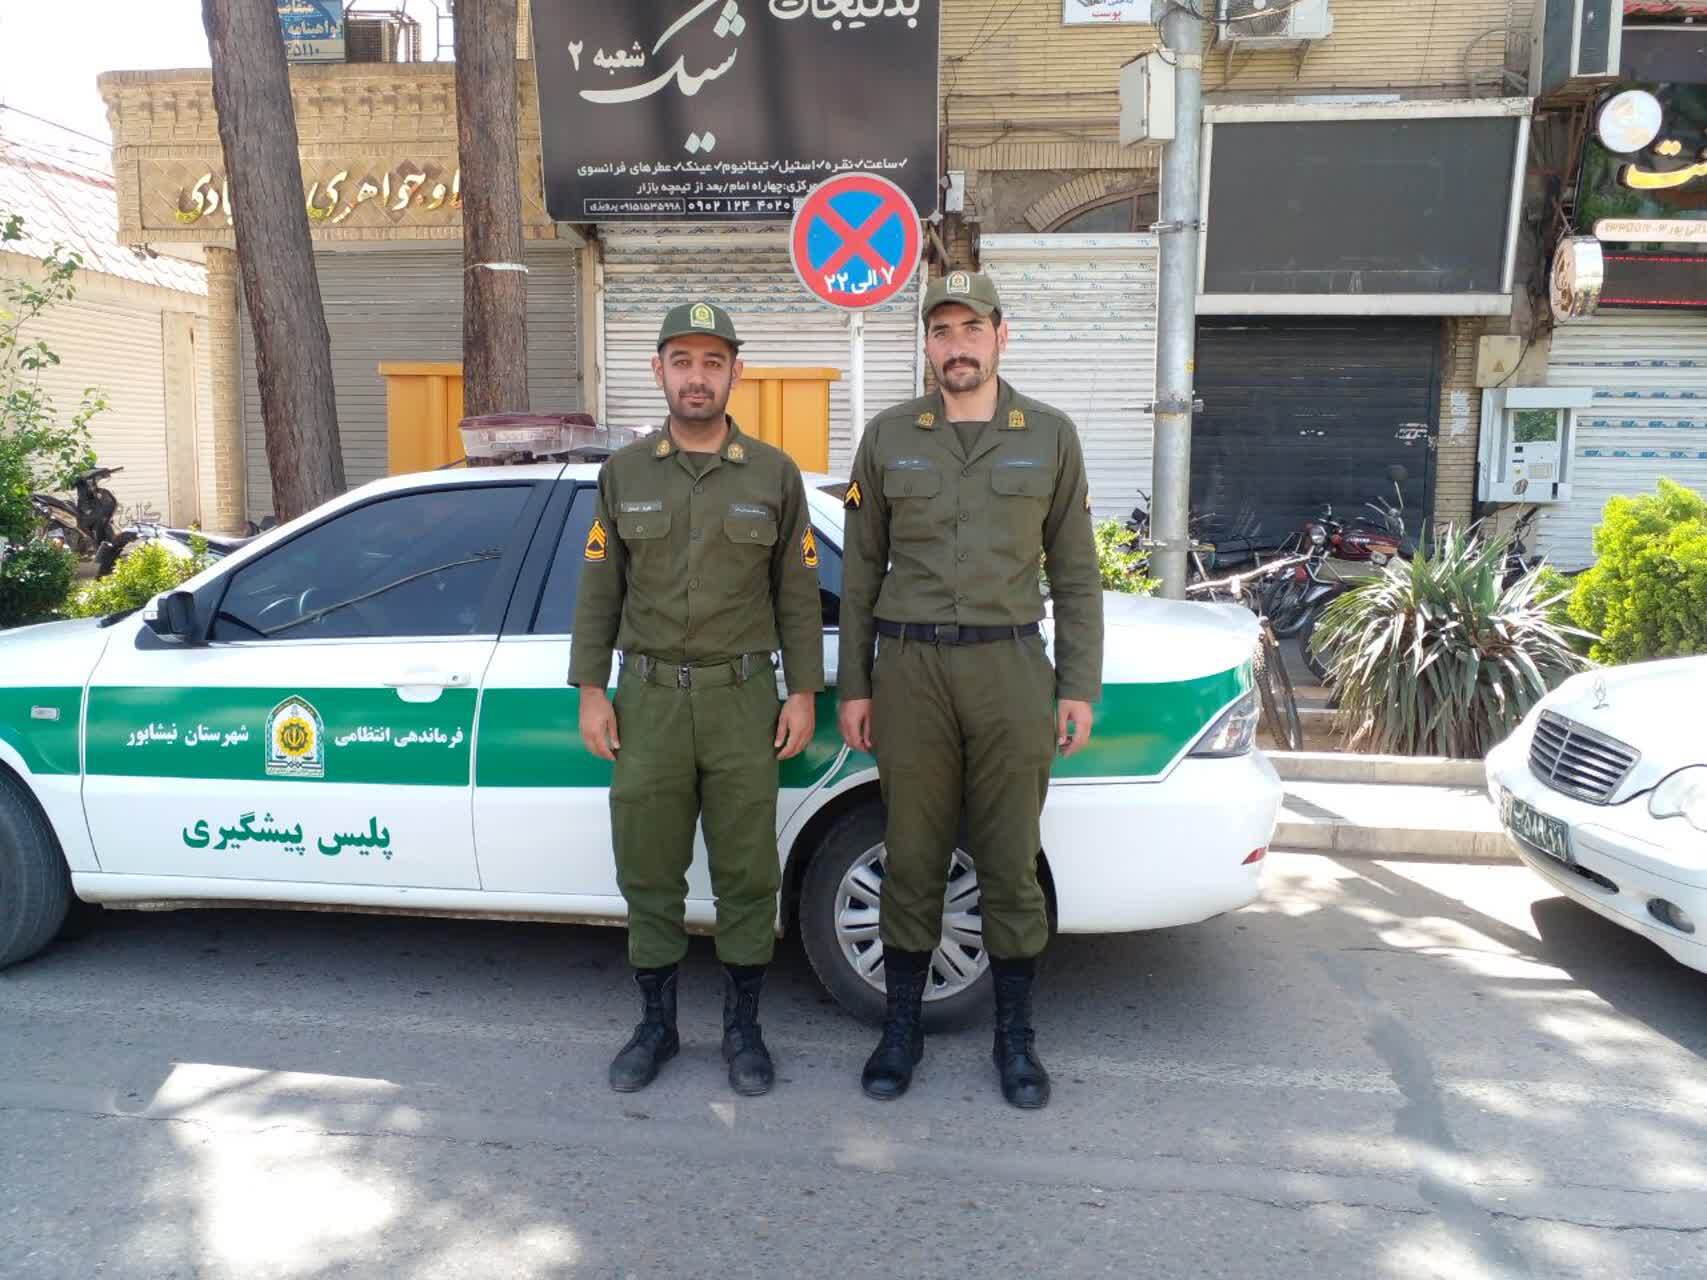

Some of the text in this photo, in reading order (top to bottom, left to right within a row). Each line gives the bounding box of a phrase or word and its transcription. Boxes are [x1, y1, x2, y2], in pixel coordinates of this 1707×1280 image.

[567, 40, 646, 75] شعبه ۲
[577, 161, 626, 177] فرانسوی
[682, 161, 713, 174] عینک
[722, 160, 769, 174] تیتانیوم
[778, 160, 816, 174] استیل
[825, 159, 854, 173] نقره
[863, 158, 898, 169] ساعت
[636, 183, 659, 195] بازار
[660, 183, 692, 196] تیمچه
[694, 182, 704, 194] از
[824, 266, 896, 294] ۷ الی ۲۲
[126, 722, 464, 748] فرماندهی انتظامی شهرستان نیشابور
[182, 812, 393, 860] پلیس پیشگیری
